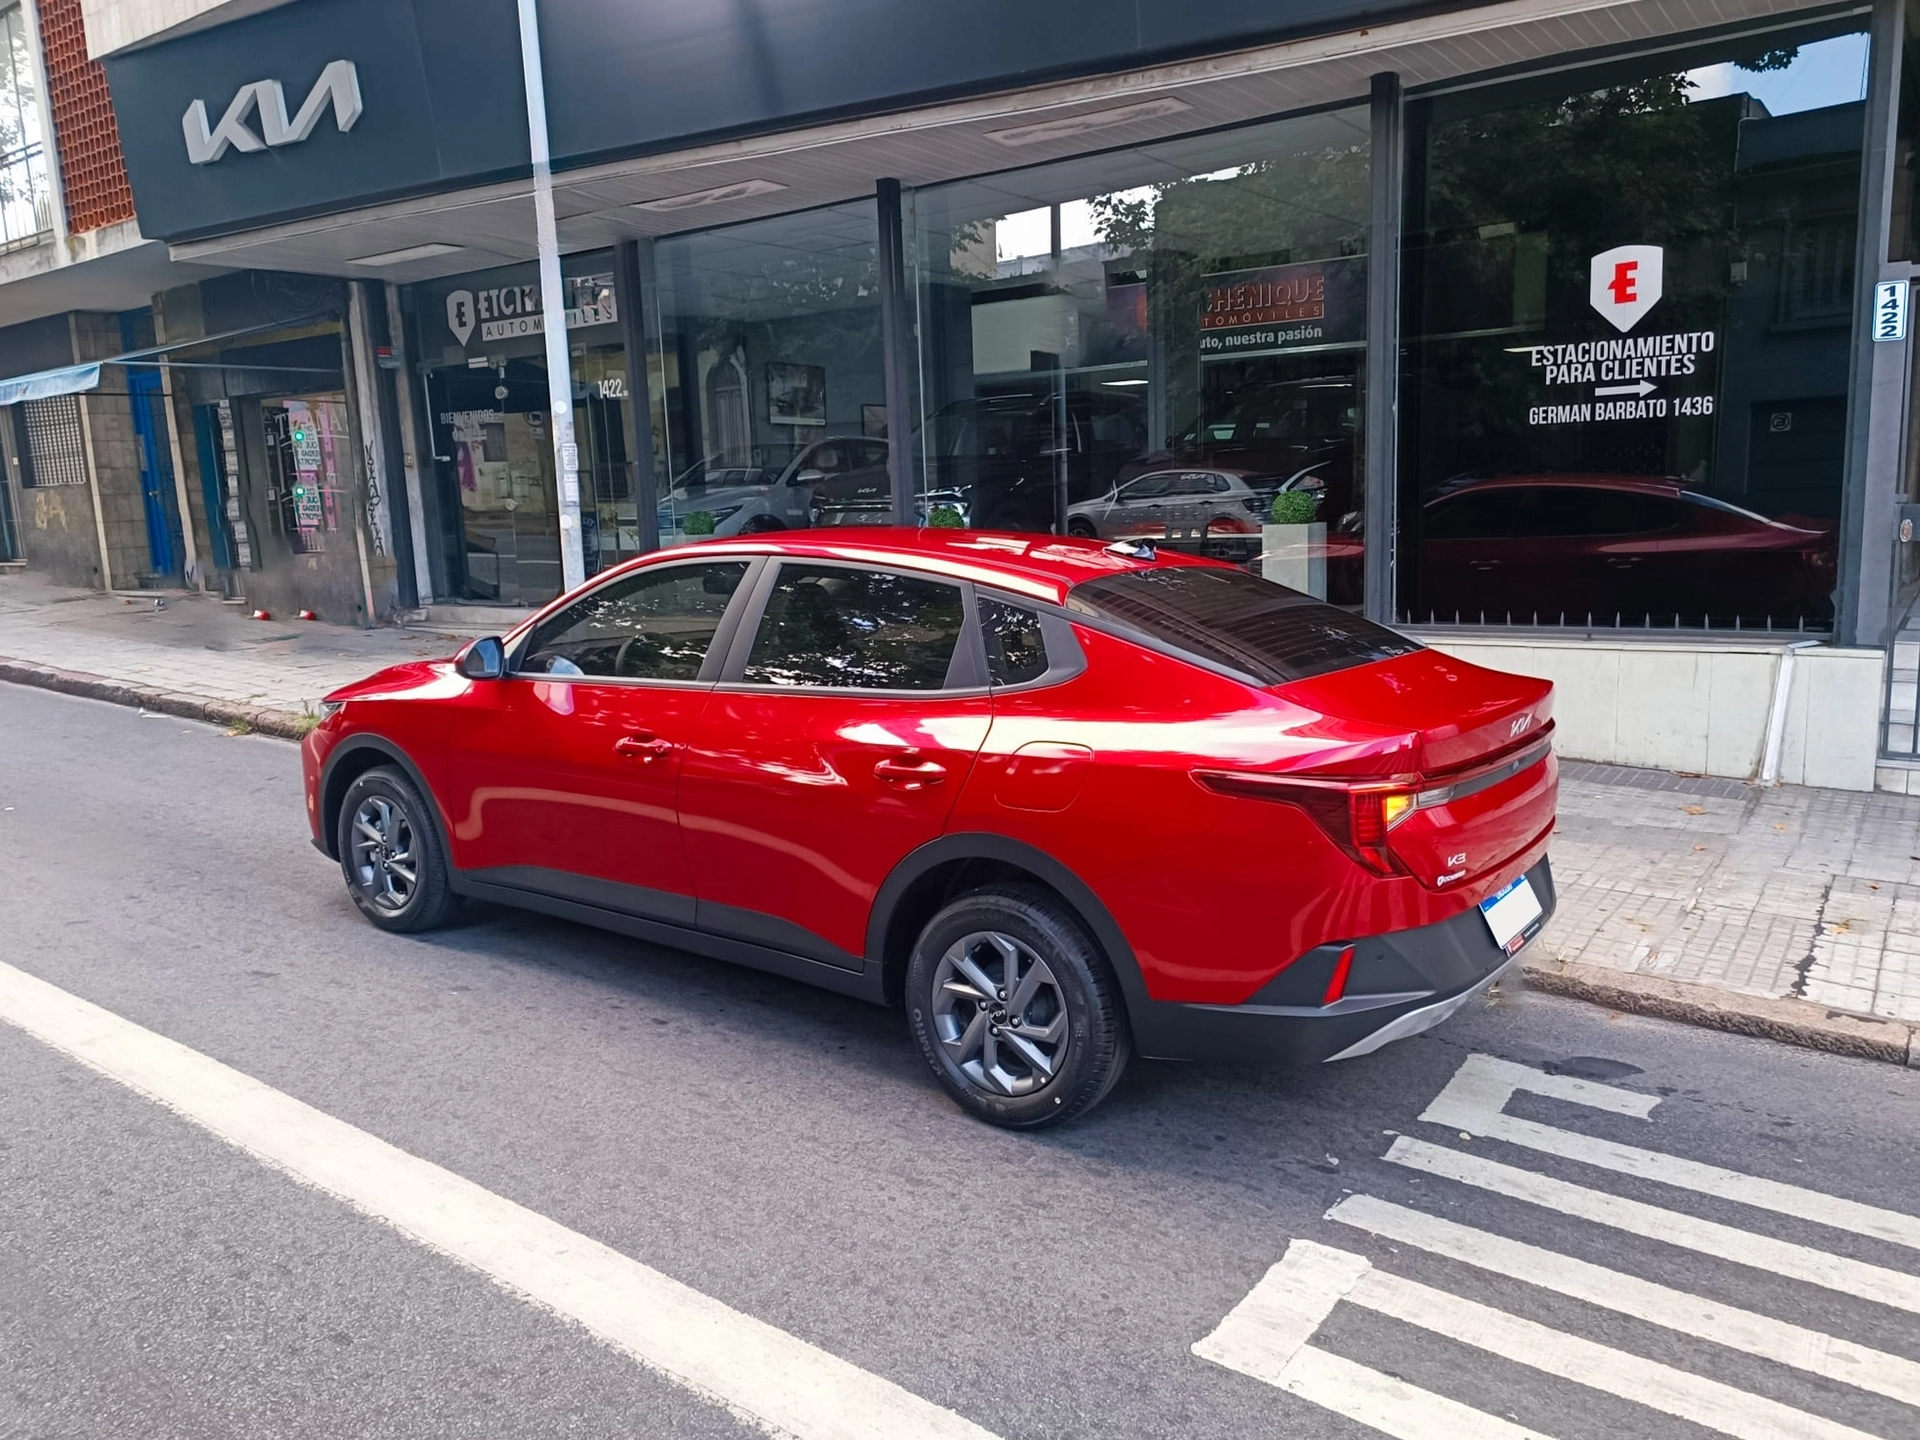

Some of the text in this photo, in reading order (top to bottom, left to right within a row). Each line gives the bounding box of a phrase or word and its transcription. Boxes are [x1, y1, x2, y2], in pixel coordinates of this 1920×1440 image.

[181, 59, 363, 165] KIA
[485, 309, 613, 338] AUTOMILES
[1880, 285, 1900, 337] 1422
[1225, 331, 1275, 346] nuestra
[1277, 325, 1322, 344] pasión
[1530, 331, 1715, 367] ESTACIONAMIENTO
[1545, 354, 1696, 385] PARA CLIENTES
[598, 378, 623, 399] 1422
[440, 409, 495, 424] BIENVENIDOS
[1529, 395, 1714, 425] GERMAN BARBATO 1436
[1447, 852, 1466, 867] K3
